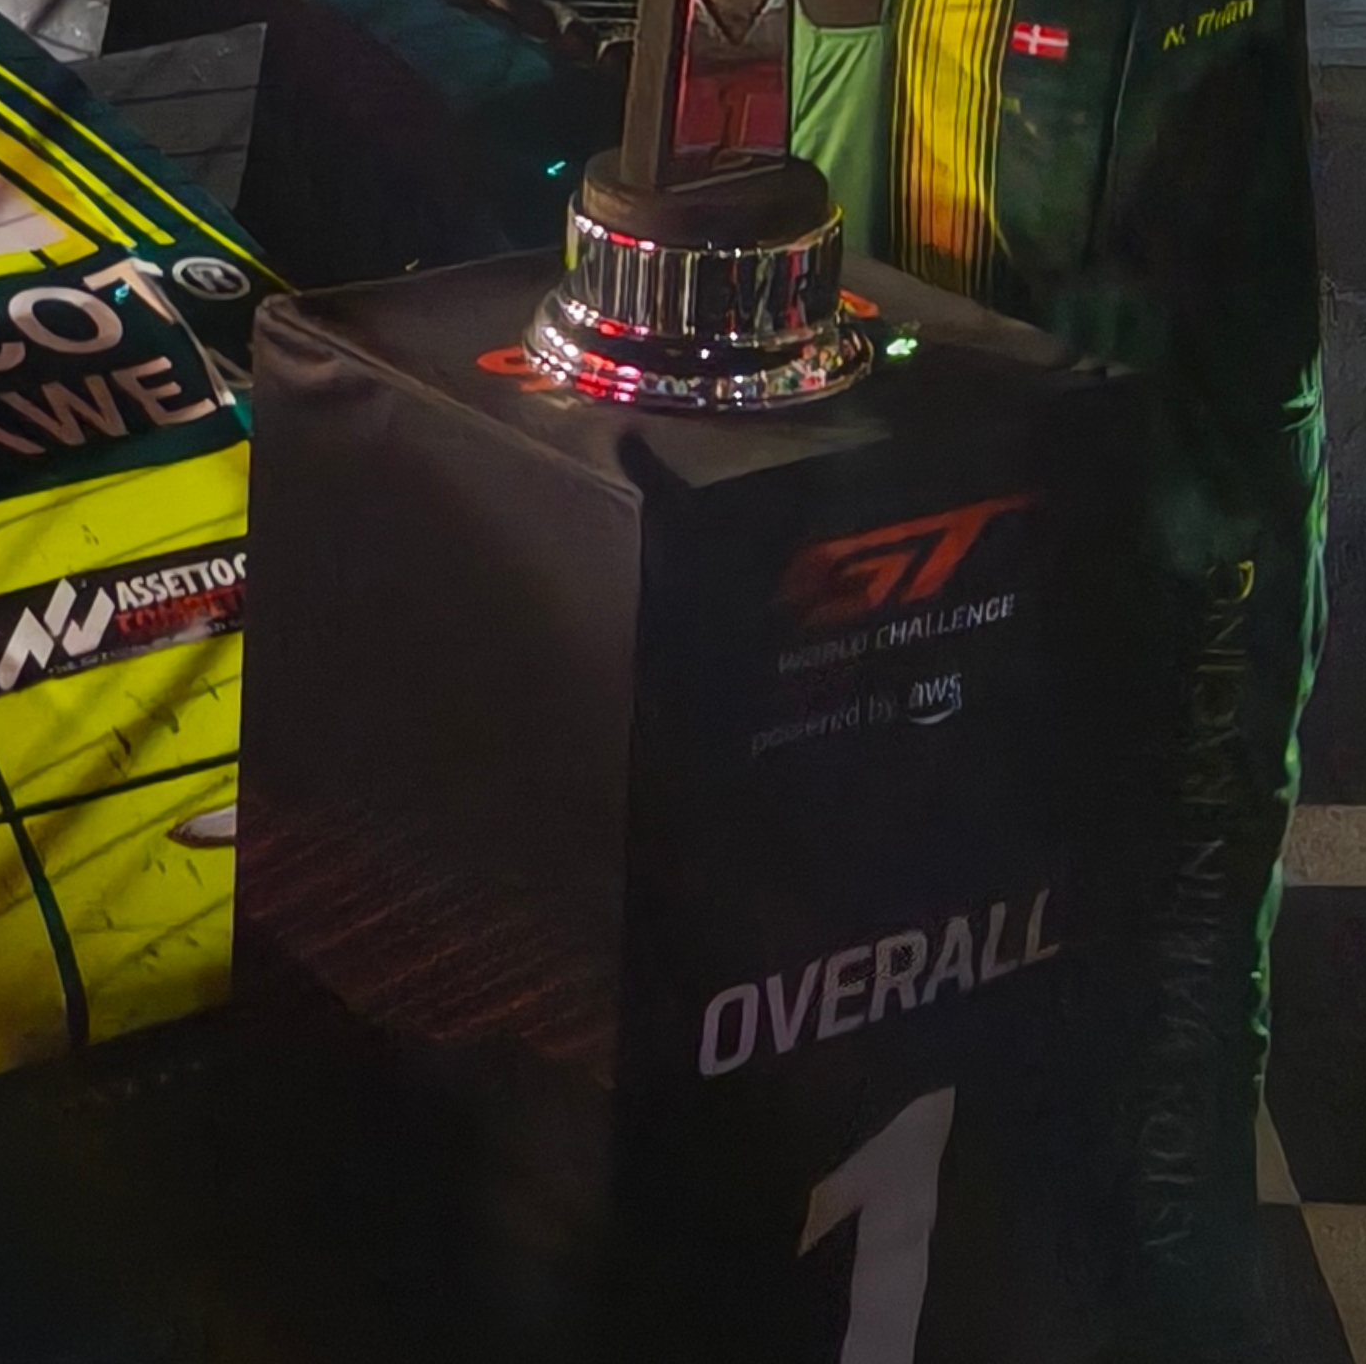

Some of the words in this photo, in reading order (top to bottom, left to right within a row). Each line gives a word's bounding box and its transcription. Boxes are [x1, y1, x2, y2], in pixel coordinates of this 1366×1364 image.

[115, 557, 235, 612] ASSETTO
[873, 592, 1016, 651] CHALLENGE
[698, 887, 1062, 1079] OVERALL
[797, 1084, 957, 1364] 1
